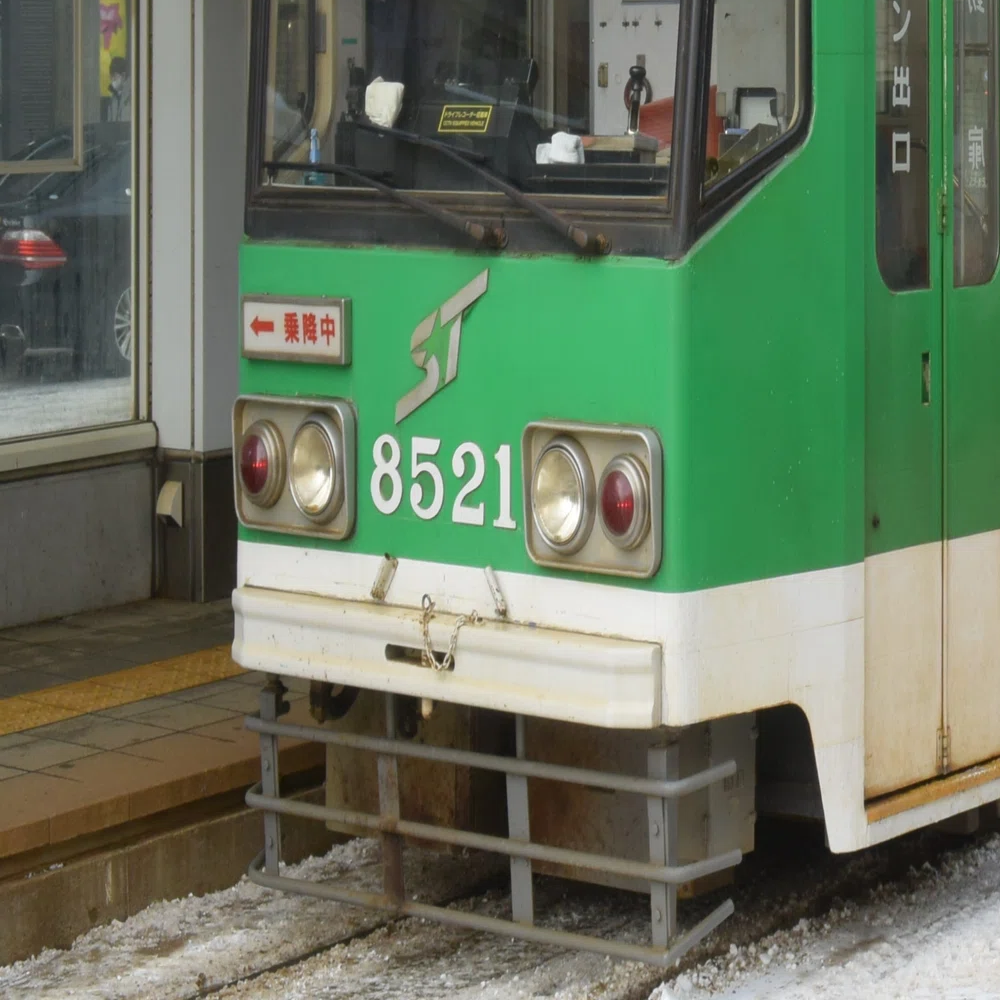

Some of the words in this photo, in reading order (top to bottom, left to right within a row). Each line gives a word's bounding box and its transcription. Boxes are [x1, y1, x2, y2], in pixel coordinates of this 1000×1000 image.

[284, 313, 336, 346] 乗降中
[370, 434, 516, 530] 8521
